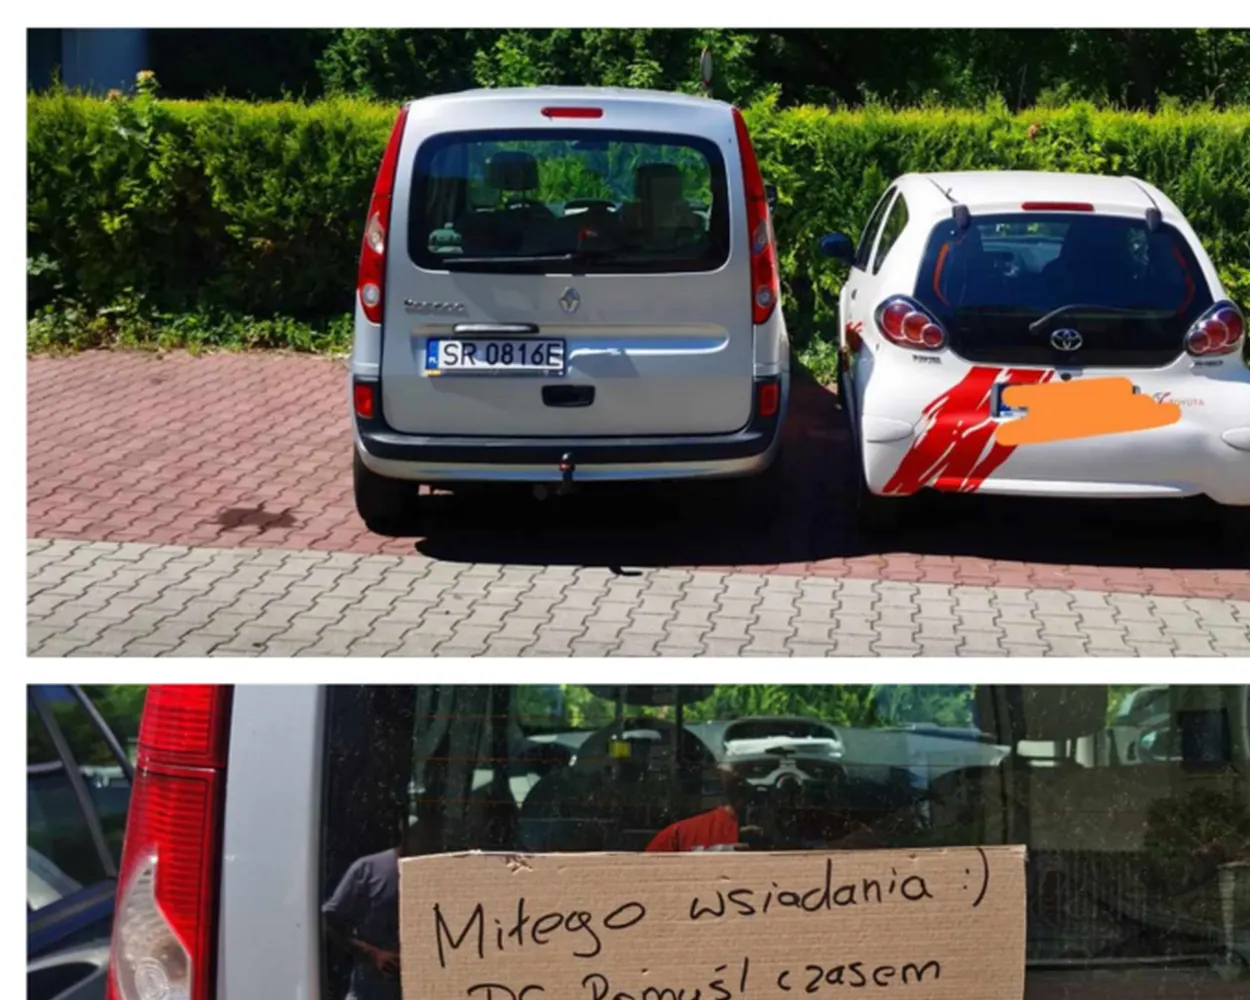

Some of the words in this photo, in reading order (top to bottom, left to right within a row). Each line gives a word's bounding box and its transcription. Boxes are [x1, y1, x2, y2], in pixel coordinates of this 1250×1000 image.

[443, 343, 475, 366] SR
[485, 342, 561, 367] 0816E
[433, 897, 646, 968] Miłego
[690, 858, 933, 920] wsiadania
[777, 960, 940, 993] czasem
